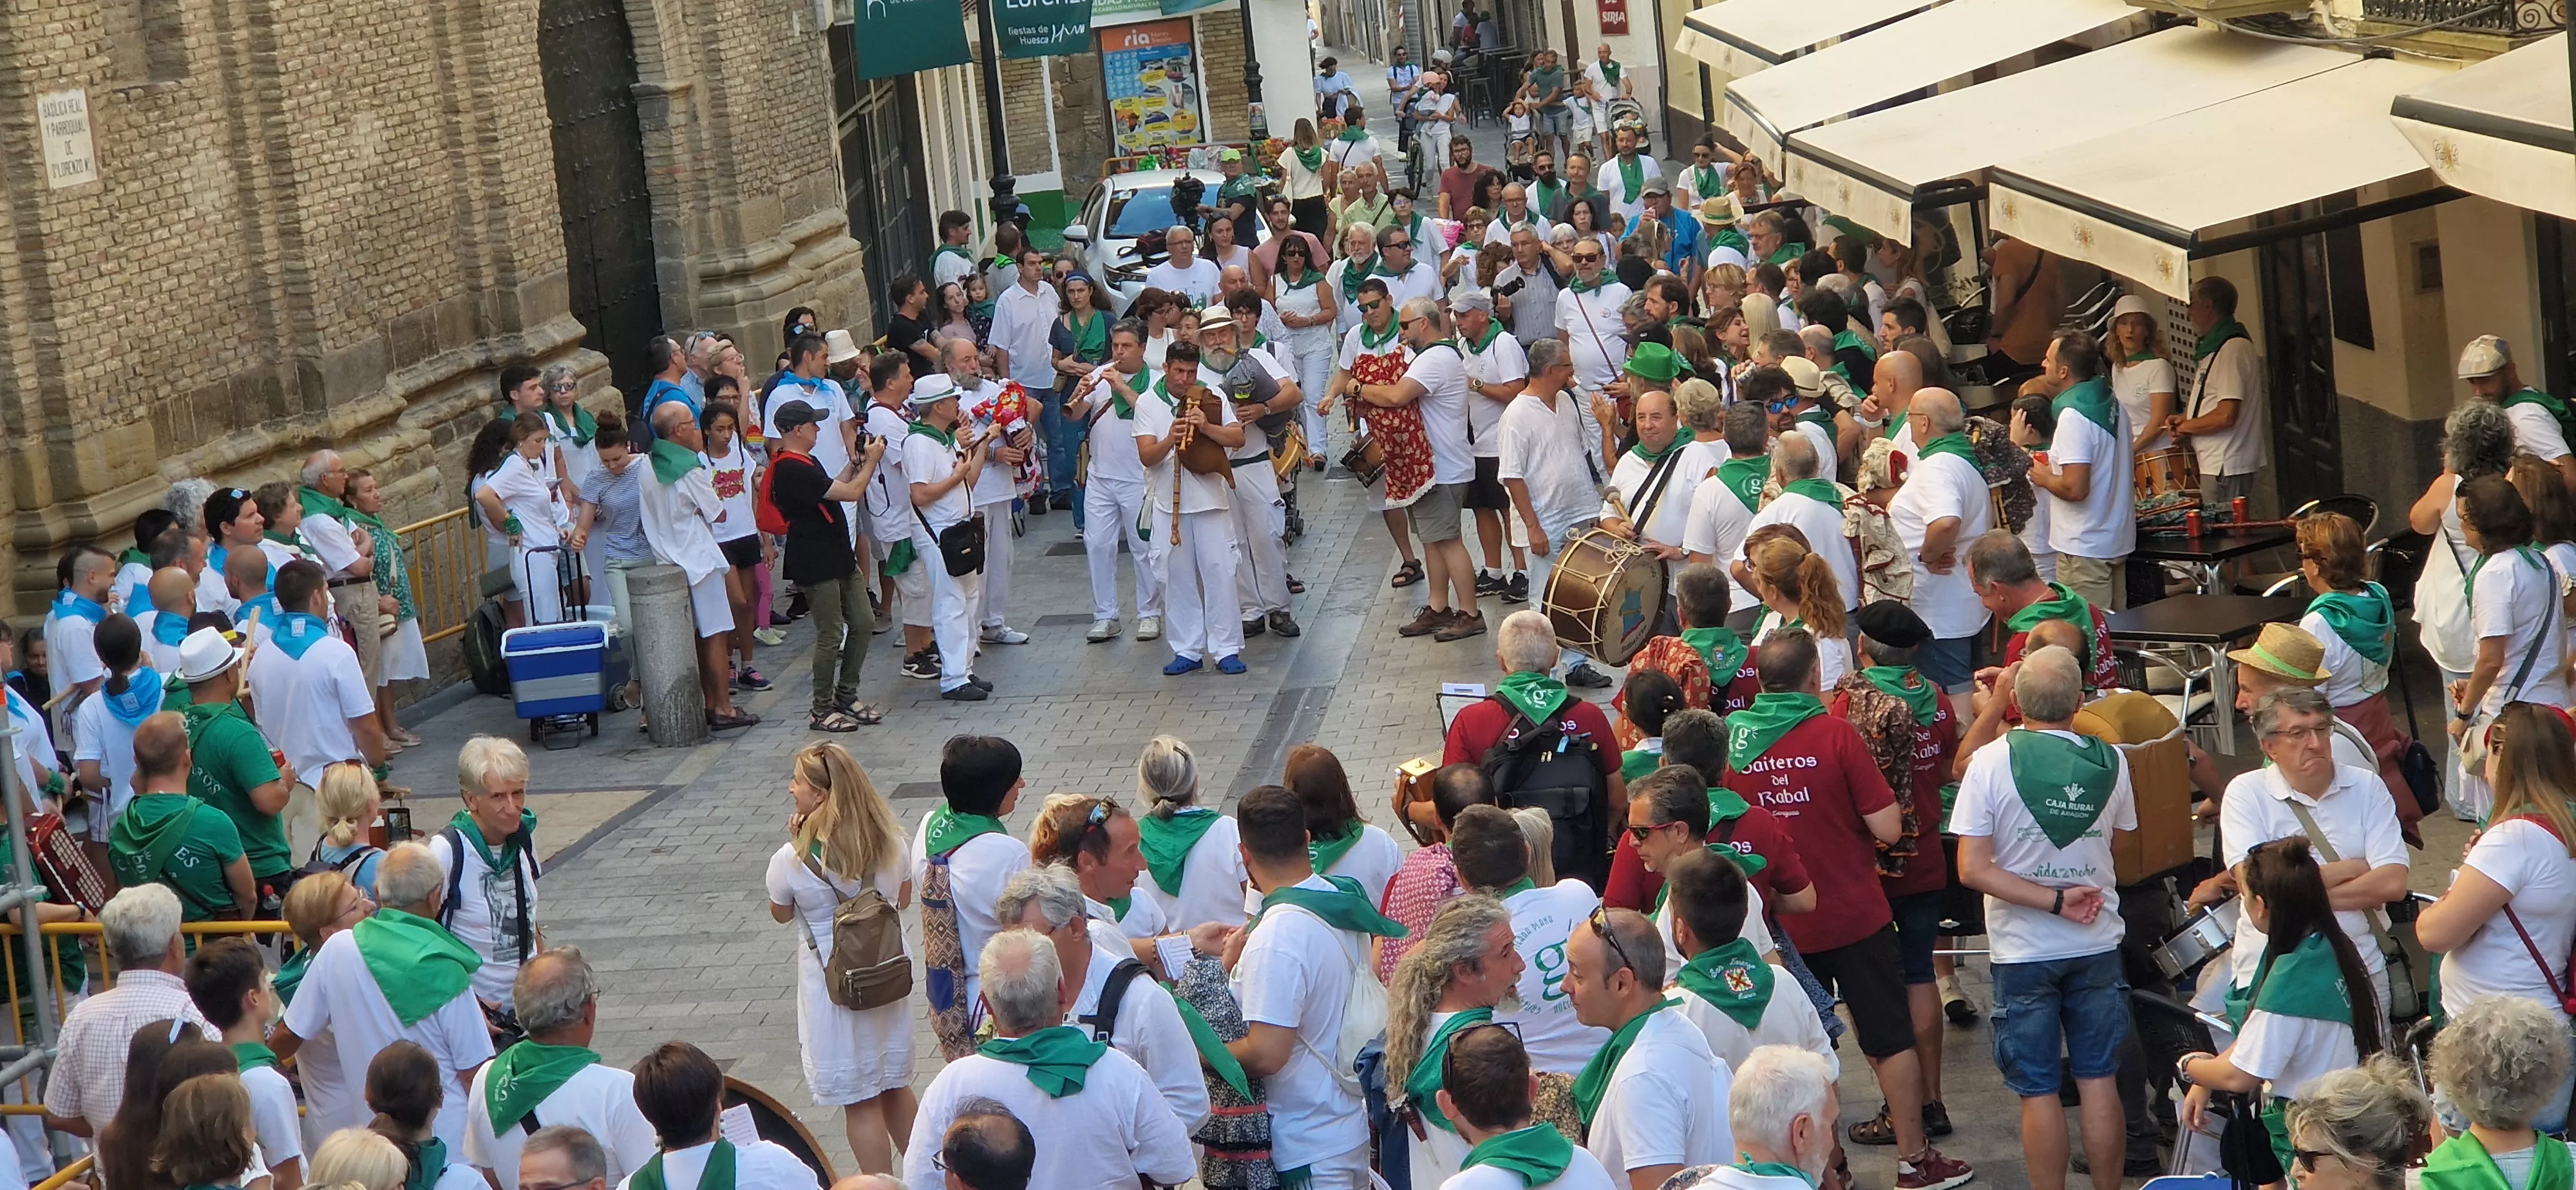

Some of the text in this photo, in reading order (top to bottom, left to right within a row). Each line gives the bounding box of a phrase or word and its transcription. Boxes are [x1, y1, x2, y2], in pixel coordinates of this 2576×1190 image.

[1602, 11, 1625, 24] SIRIA
[1008, 26, 1036, 35] fiestas
[1124, 29, 1150, 46] ria
[68, 99, 82, 113] REAL
[46, 118, 86, 138] Y PARROQUIAL
[65, 140, 73, 155] DE
[1736, 727, 1751, 750] g
[1771, 774, 1789, 786] del
[1757, 786, 1810, 807] Rabal
[2046, 798, 2094, 811] CAJA RURAL
[1531, 915, 1554, 931] PLANA
